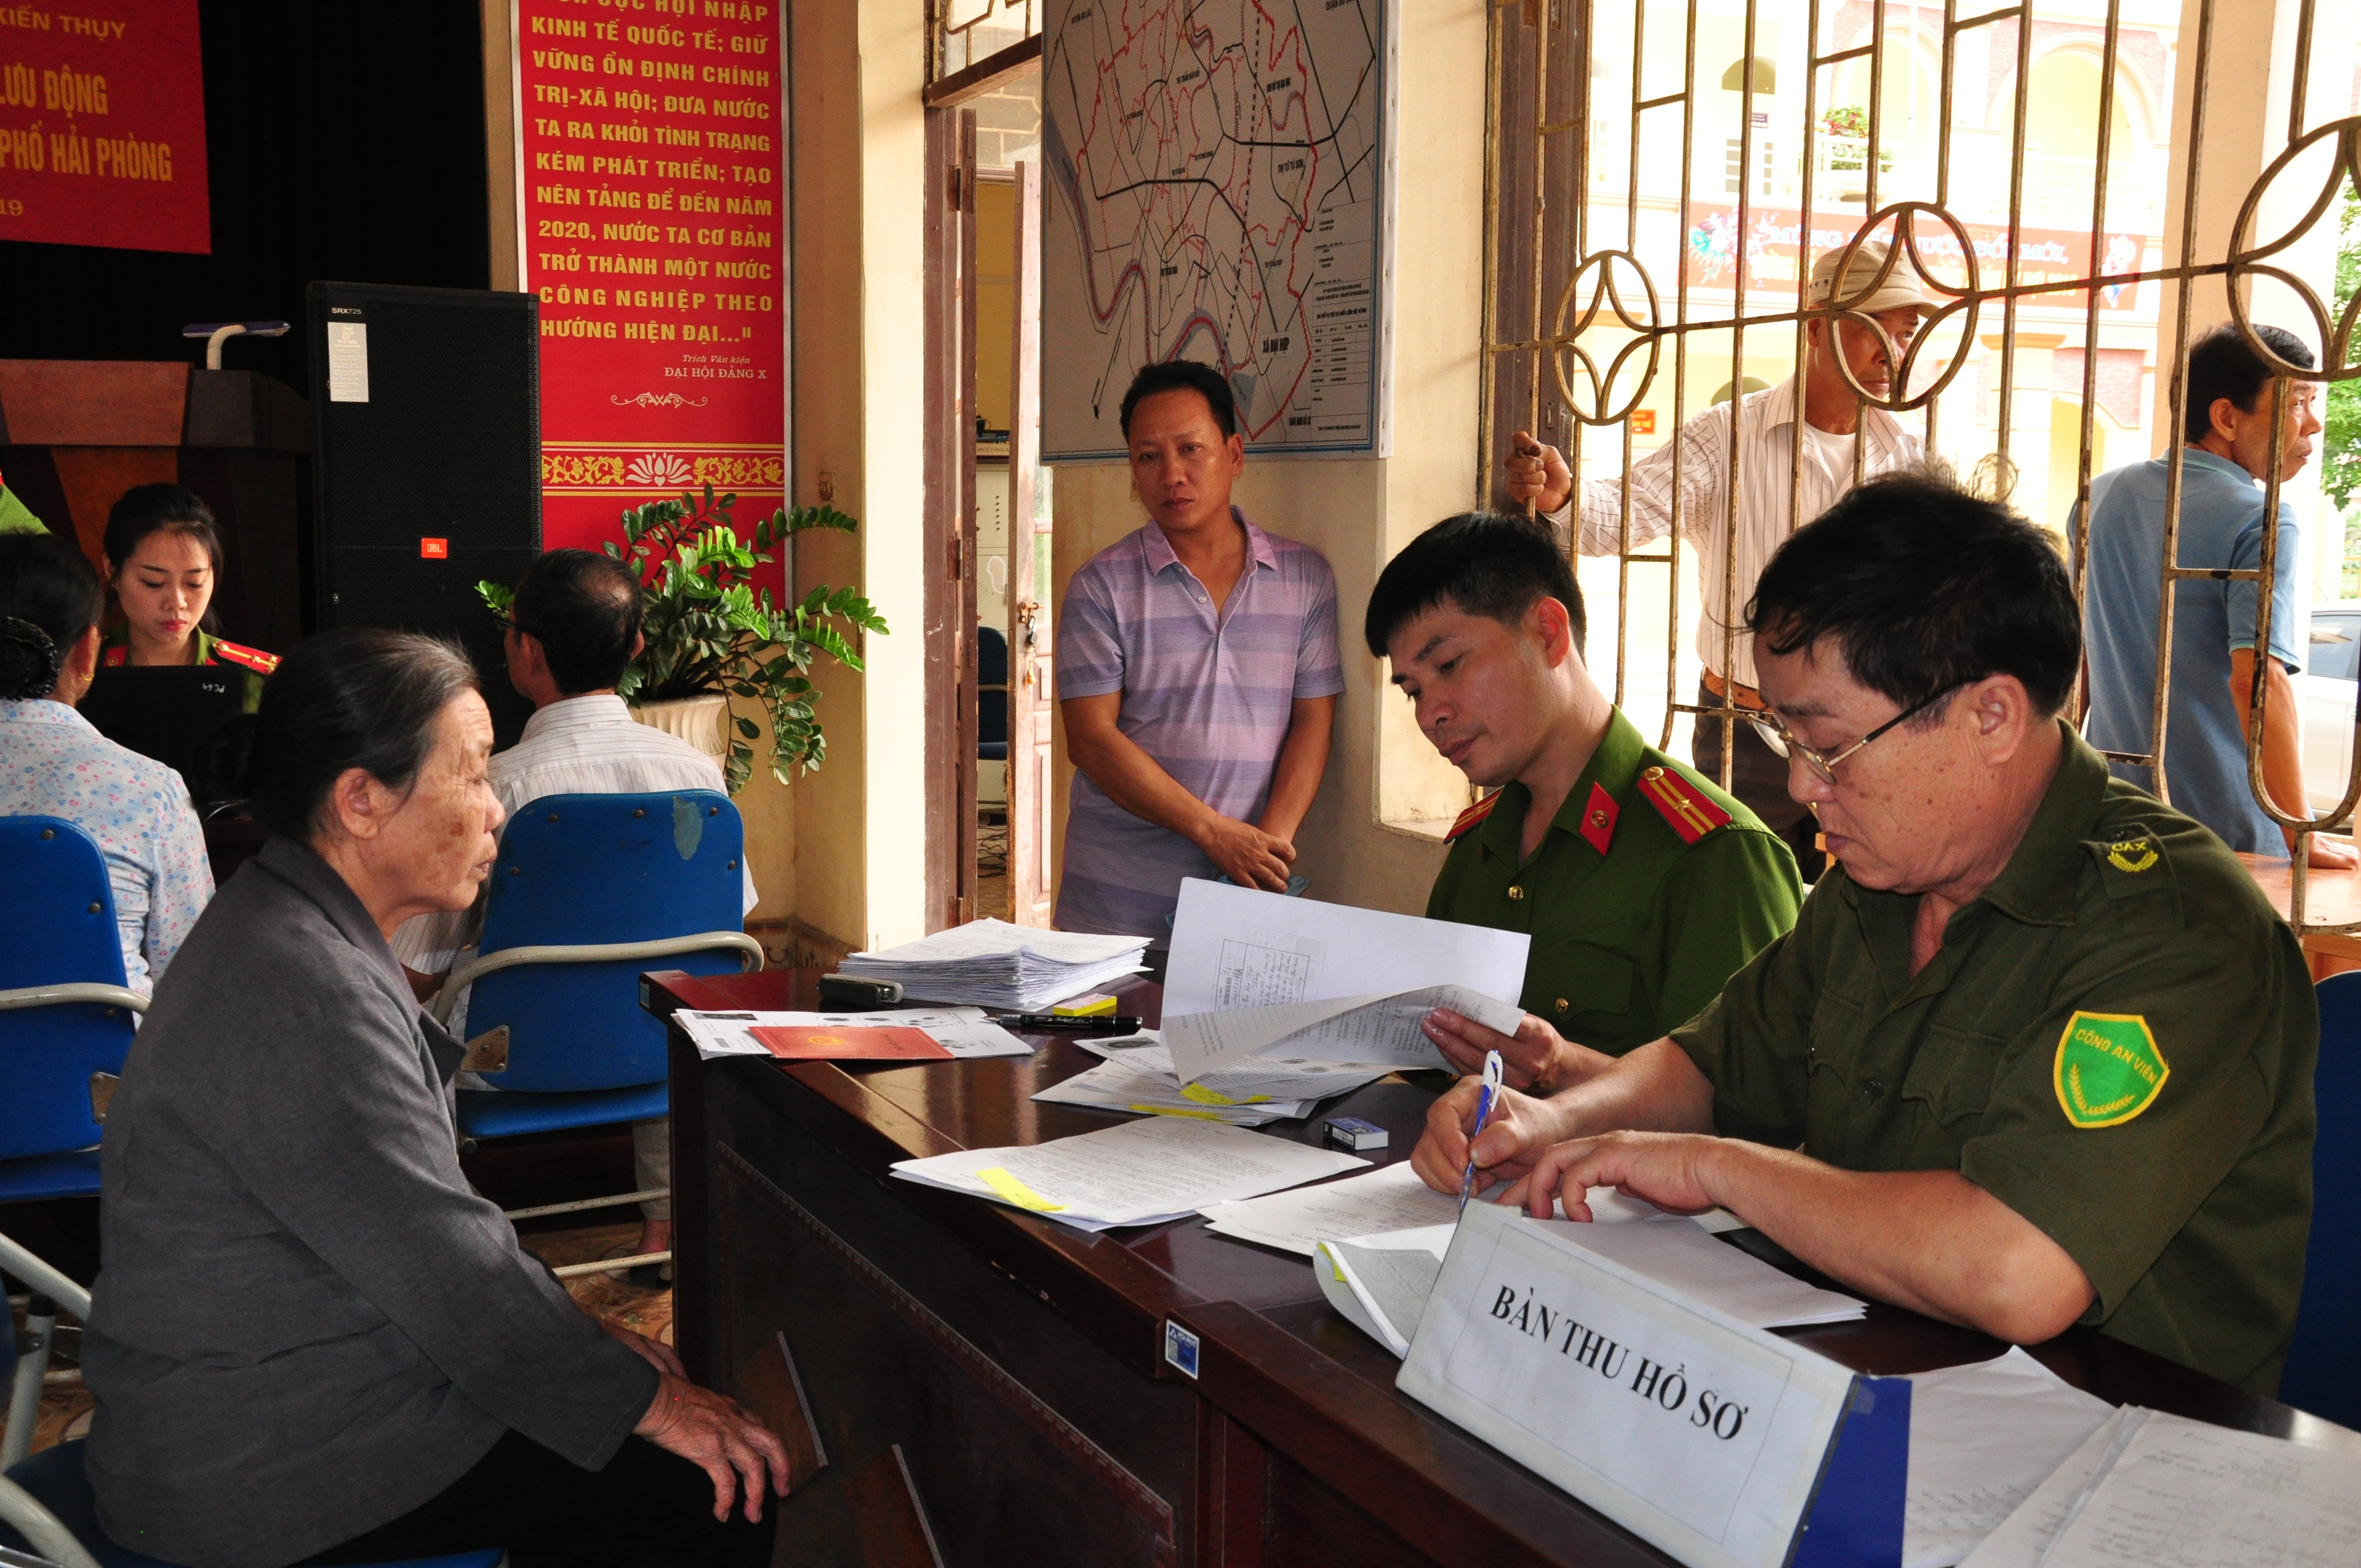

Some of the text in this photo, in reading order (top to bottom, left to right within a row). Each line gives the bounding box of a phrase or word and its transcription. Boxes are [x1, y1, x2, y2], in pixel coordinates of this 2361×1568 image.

[704, 0, 768, 24] NHẬP
[59, 15, 126, 41] THỤY
[531, 15, 768, 54] KINH TẾ QUỐC TẾ; GIỮ
[532, 47, 769, 87] VỮNG ỔN ĐỊNH CHÍNH
[43, 64, 108, 118] ĐỘNG
[534, 84, 769, 119] TRỊ-XÃ HỘI; ĐƯA NƯỚC
[535, 118, 770, 153] TA RA KHỎI TÌNH TRẠNG
[51, 124, 90, 175] HẢI
[96, 132, 172, 182] PHÒNG
[536, 150, 771, 186] KÉM PHÁT TRIỂN; TẠO
[537, 183, 771, 216] NÊN TẢNG ĐỂ ĐẾN NĂM
[538, 220, 771, 248] 2020, NƯỚC TA CƠ BẢN
[538, 247, 771, 280] TRỞ THÀNH MỘT NƯỚC
[539, 284, 772, 312] CÔNG NGHIỆP THEO
[541, 316, 617, 339] HƯỚNG
[624, 320, 676, 344] HIỆN
[665, 366, 766, 379] ĐẠI HỘI ĐẢNG X
[683, 354, 706, 362] Trích
[730, 356, 750, 365] kiện
[426, 543, 442, 553] JBL
[2111, 841, 2147, 852] CAX
[2112, 1046, 2134, 1062] AN
[1489, 1284, 1750, 1441] BÀN THU HỒ SƠ
